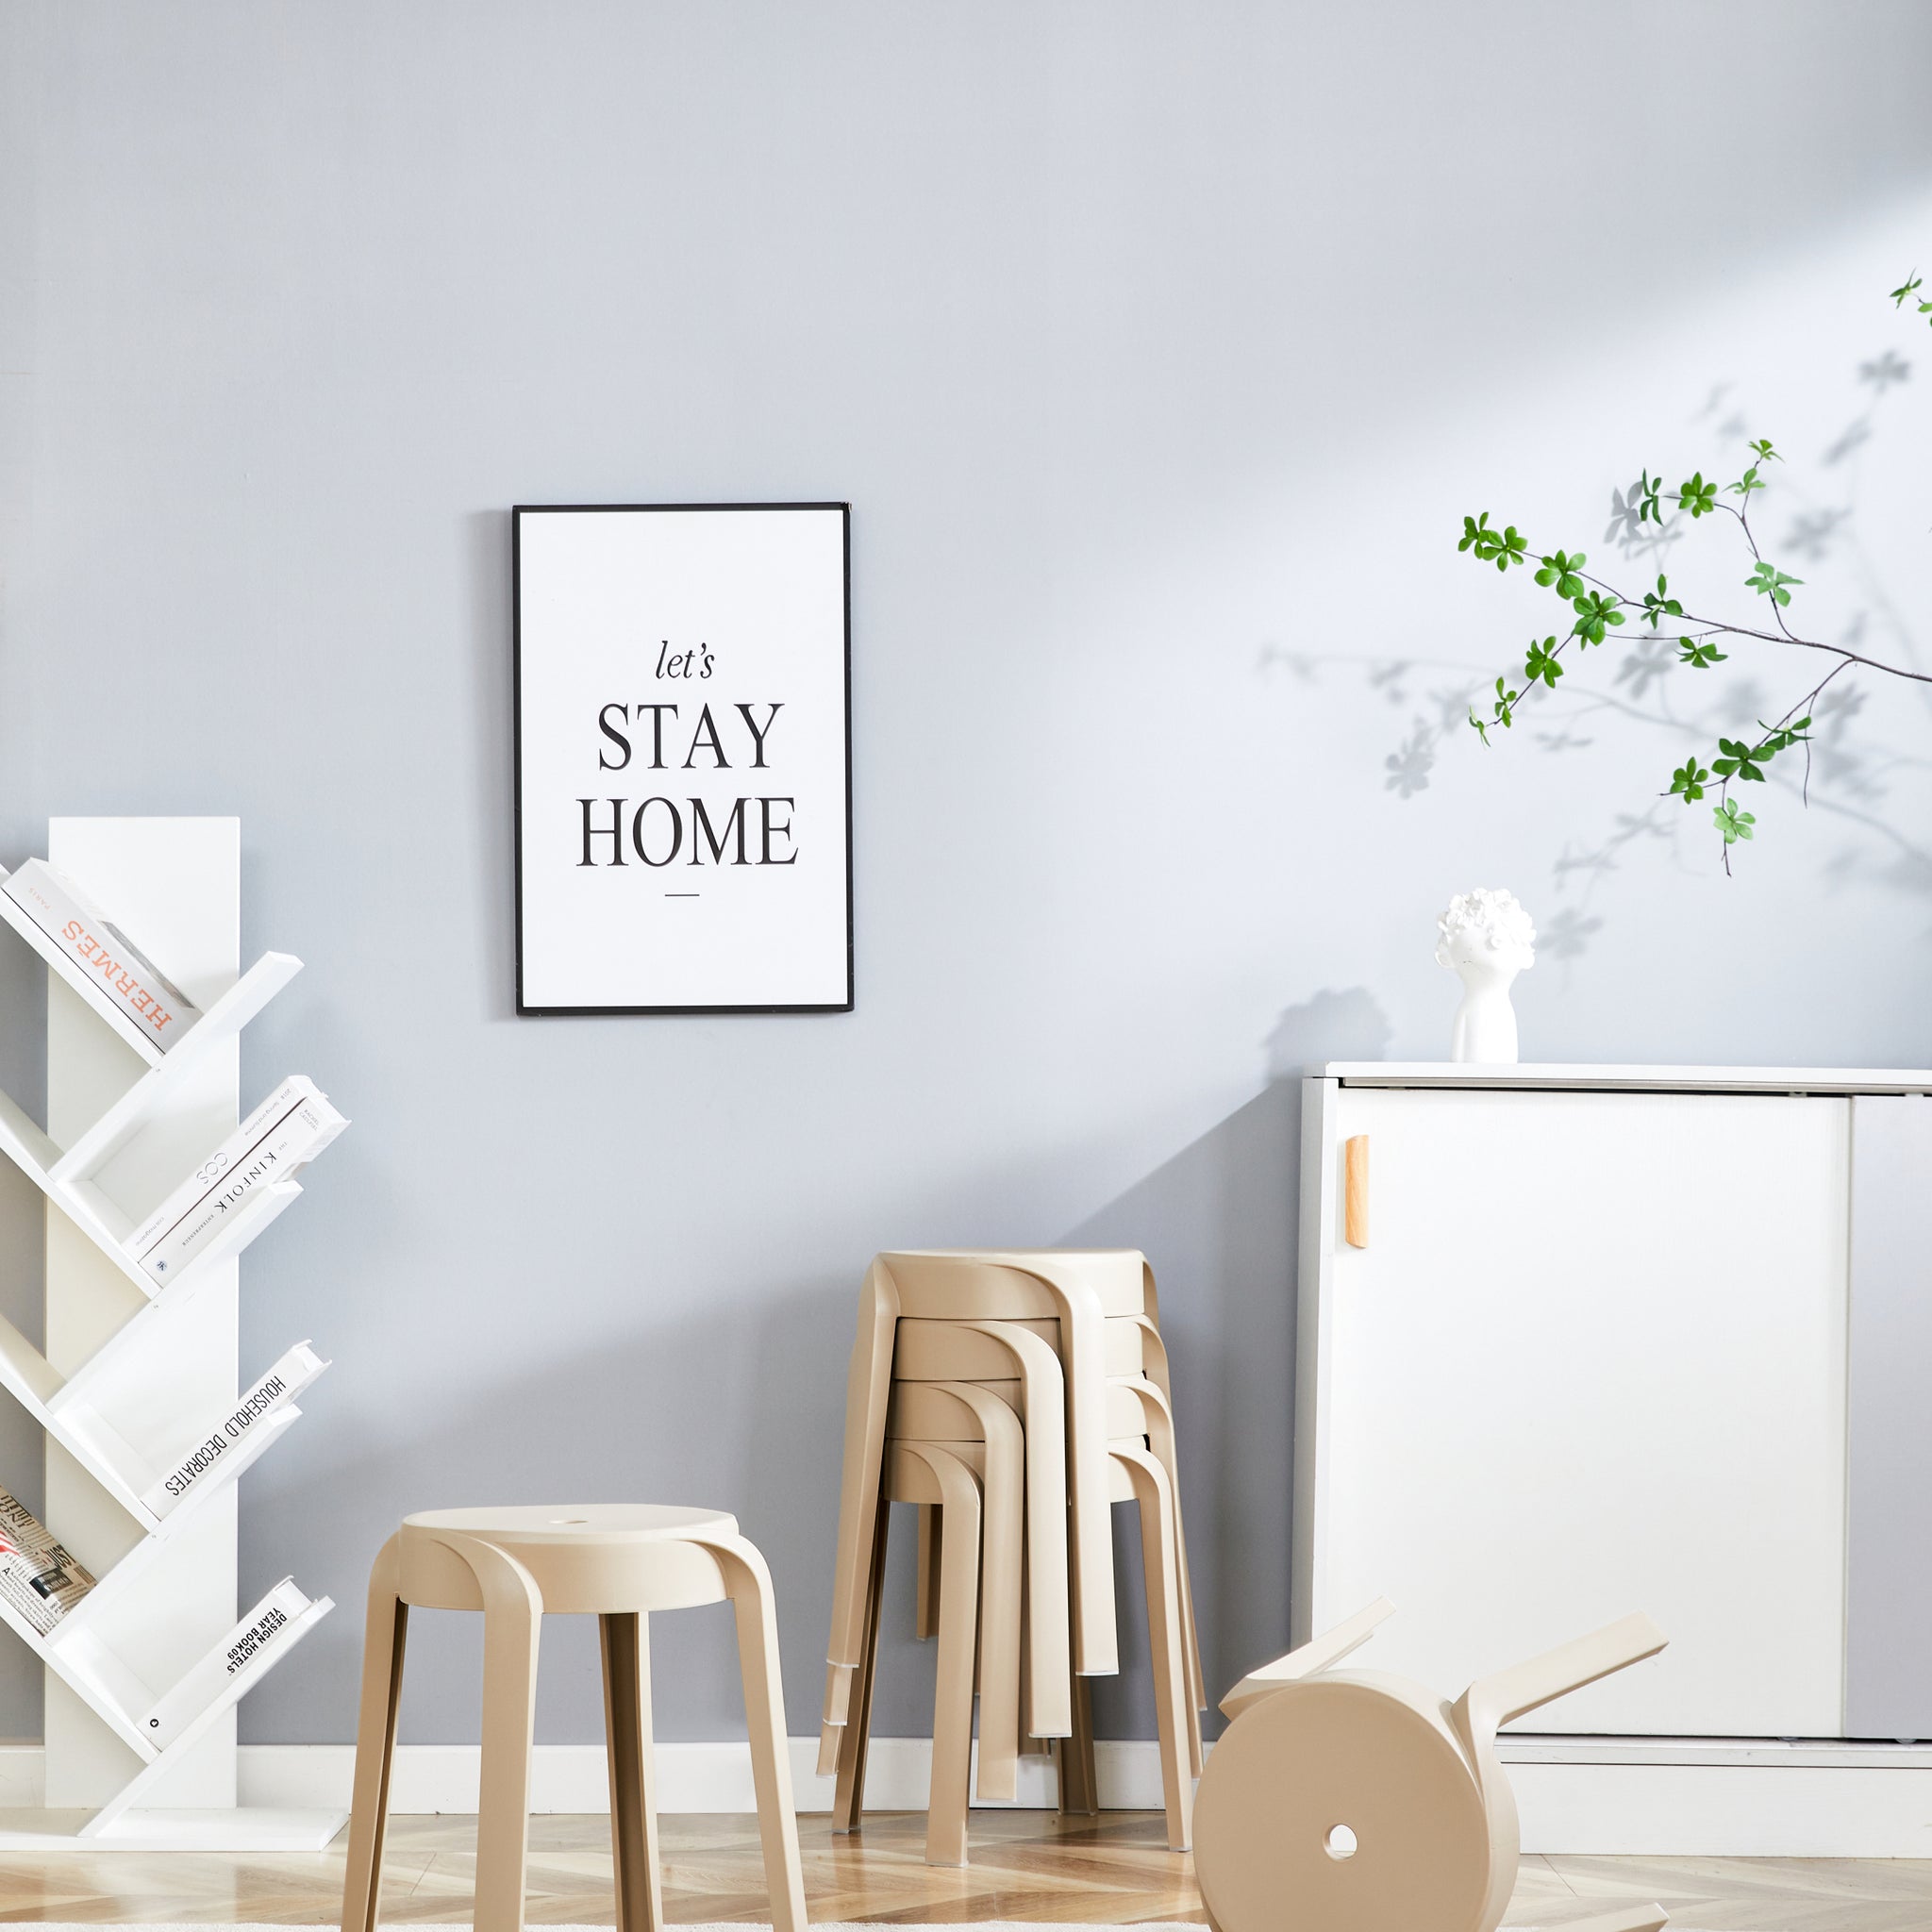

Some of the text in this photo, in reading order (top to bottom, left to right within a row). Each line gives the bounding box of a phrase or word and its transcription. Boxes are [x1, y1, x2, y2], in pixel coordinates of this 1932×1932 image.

[656, 641, 714, 679] let’s
[599, 703, 785, 770] STAY
[576, 797, 798, 867] HOME
[196, 1152, 228, 1185] COS
[214, 1152, 276, 1212] KINFOLK
[165, 1375, 286, 1495] HOUSEHOLD DECORATES
[227, 1614, 287, 1673] DESIGN HOTELS
[258, 1607, 280, 1629] YEAR
